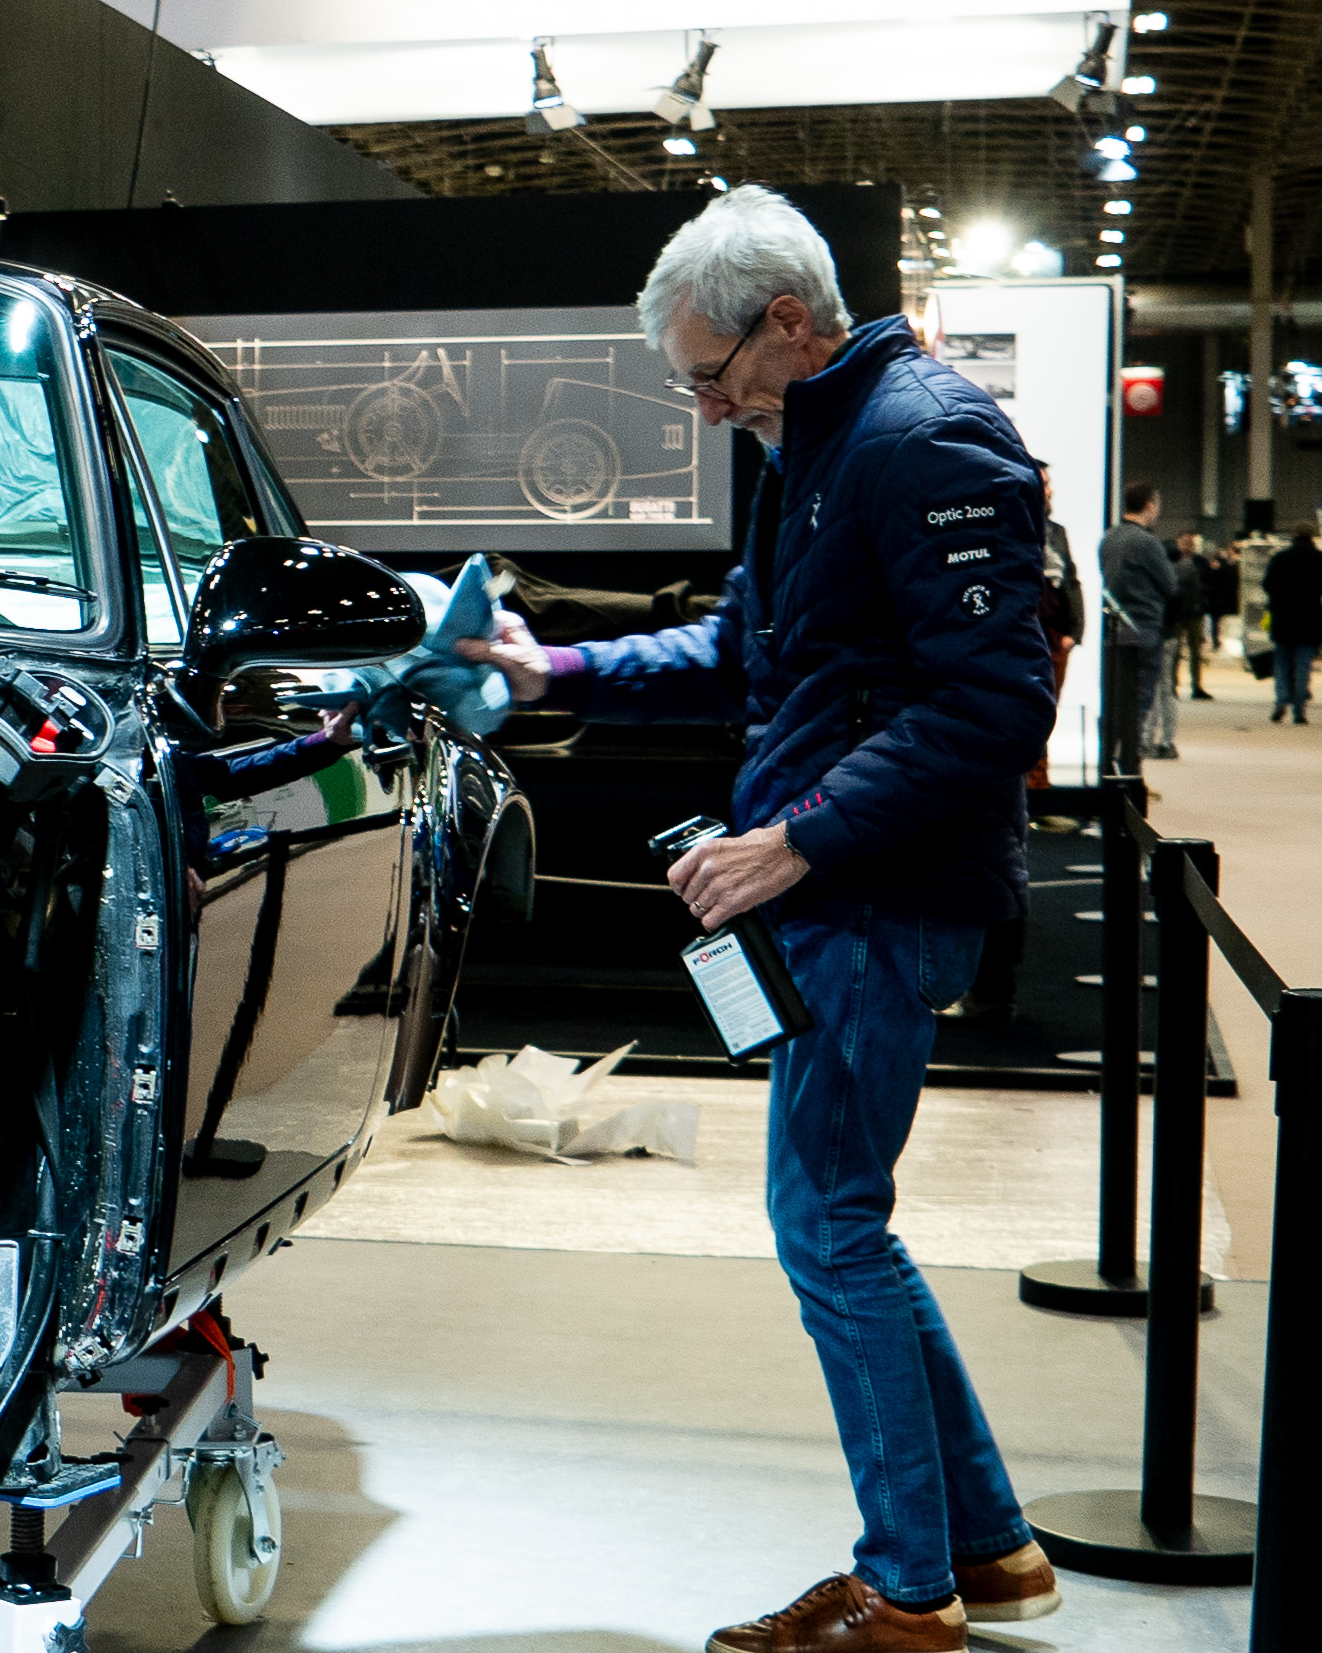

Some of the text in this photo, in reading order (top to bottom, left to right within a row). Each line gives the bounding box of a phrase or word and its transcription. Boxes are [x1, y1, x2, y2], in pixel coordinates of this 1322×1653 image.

[926, 505, 995, 527] Optic 2000
[946, 548, 991, 564] MOTUL
